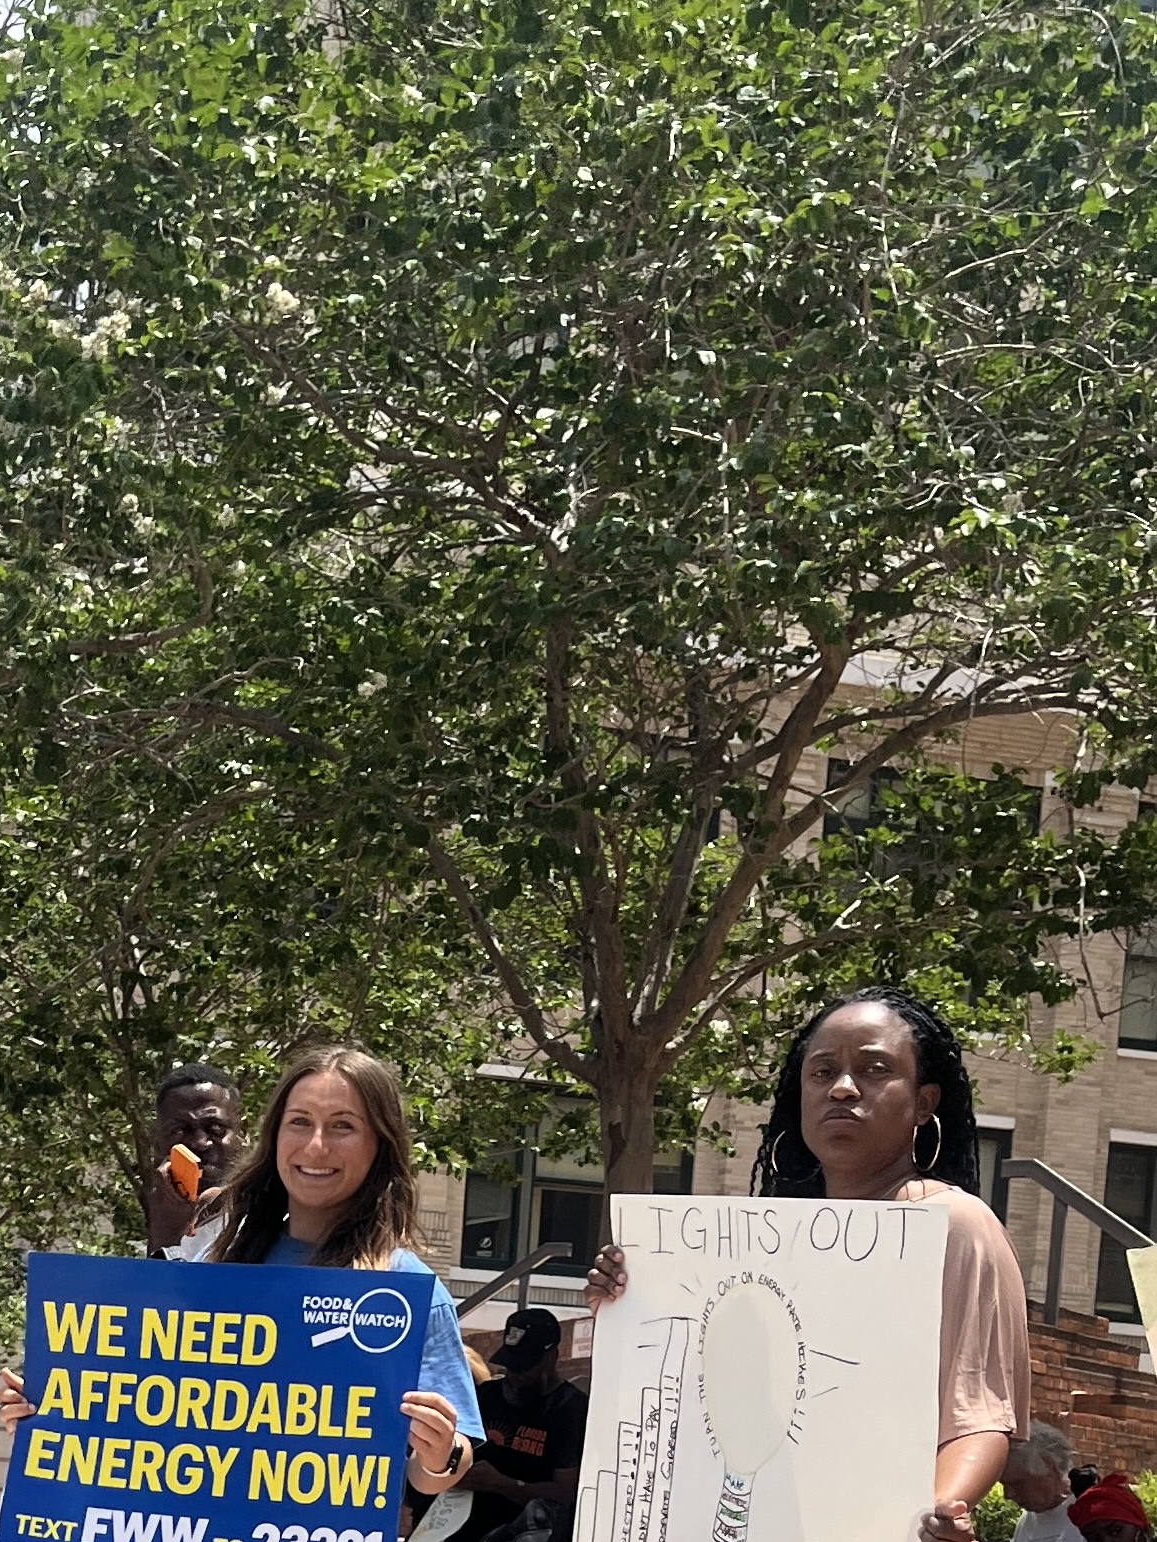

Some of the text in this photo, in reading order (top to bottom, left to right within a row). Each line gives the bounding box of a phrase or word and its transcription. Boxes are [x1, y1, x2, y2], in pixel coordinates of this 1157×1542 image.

[618, 1206, 929, 1262] LIGHTS OUT
[302, 1295, 353, 1311] FOOD&
[717, 1275, 737, 1296] OUT
[741, 1271, 754, 1285] ON
[758, 1274, 786, 1302] ENERGY
[44, 1301, 278, 1366] WE NEED
[303, 1310, 406, 1329] WATER WATCH
[37, 1368, 377, 1439] AFFORDABLE
[24, 1430, 241, 1498] ENERGY
[248, 1449, 391, 1509] NOW!
[16, 1514, 78, 1542] TEXT
